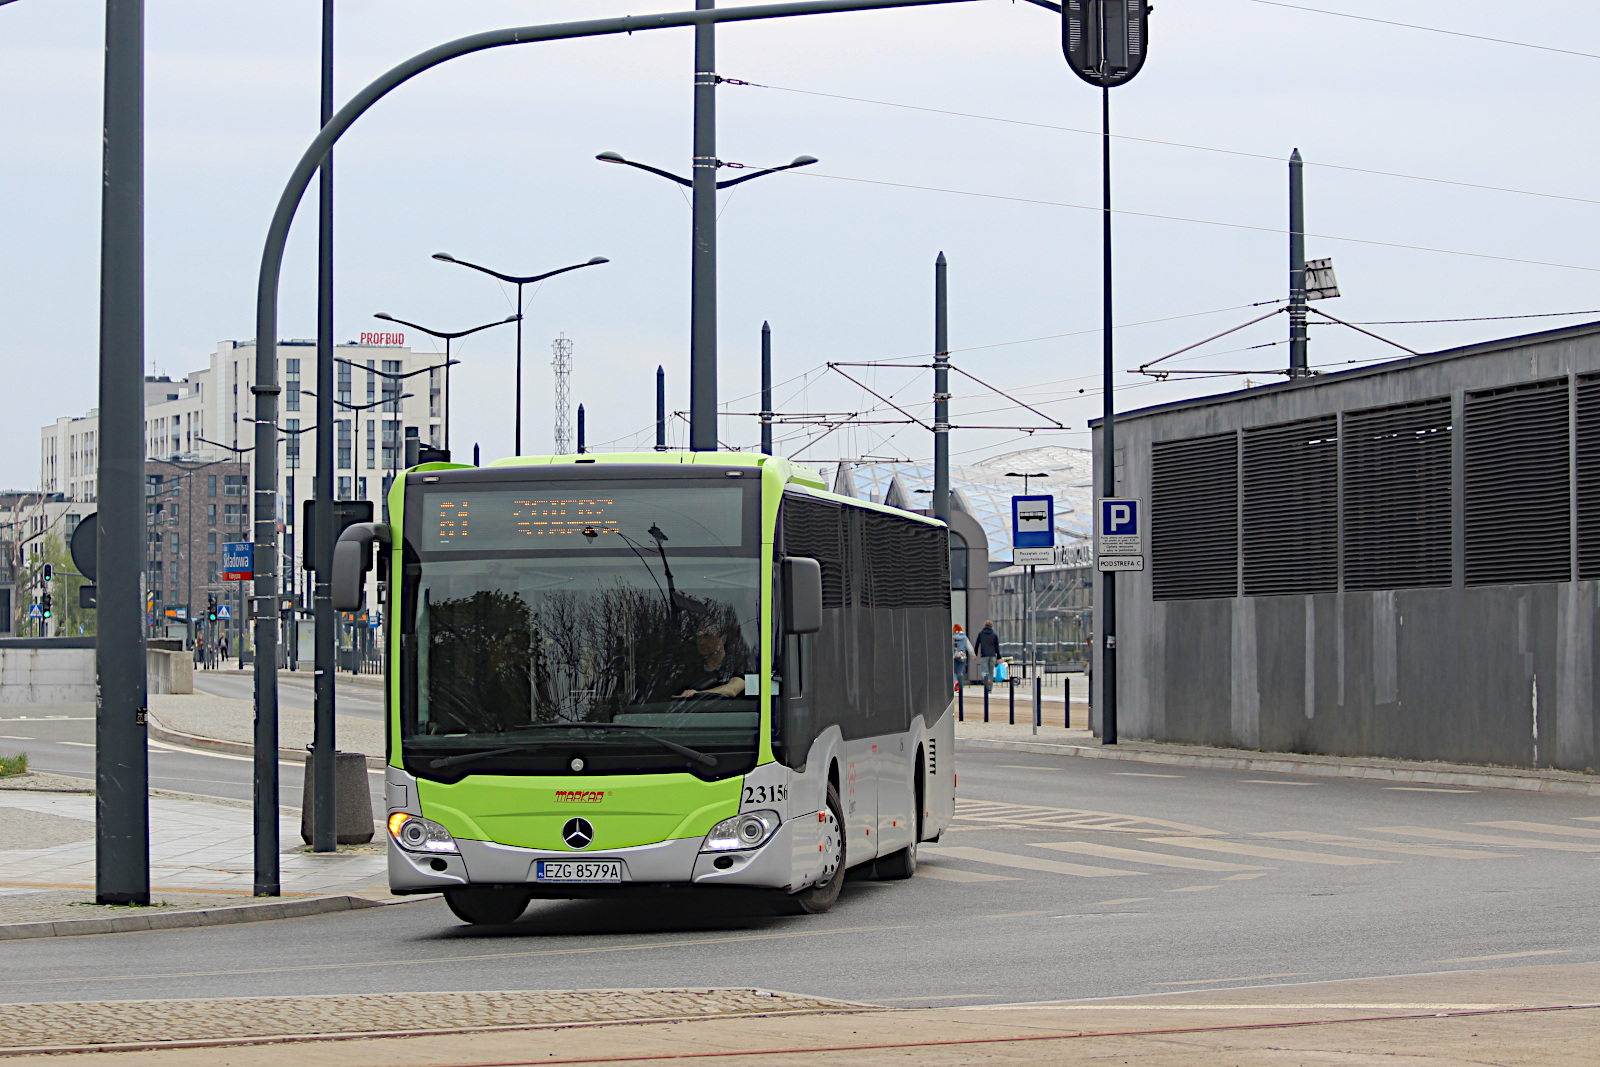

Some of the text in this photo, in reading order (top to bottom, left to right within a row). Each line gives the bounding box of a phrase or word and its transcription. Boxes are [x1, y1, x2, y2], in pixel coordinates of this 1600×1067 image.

[360, 332, 405, 345] PROFBUD
[1110, 504, 1131, 532] P
[743, 784, 788, 804] 23156
[545, 863, 619, 878] EZG 8579A
